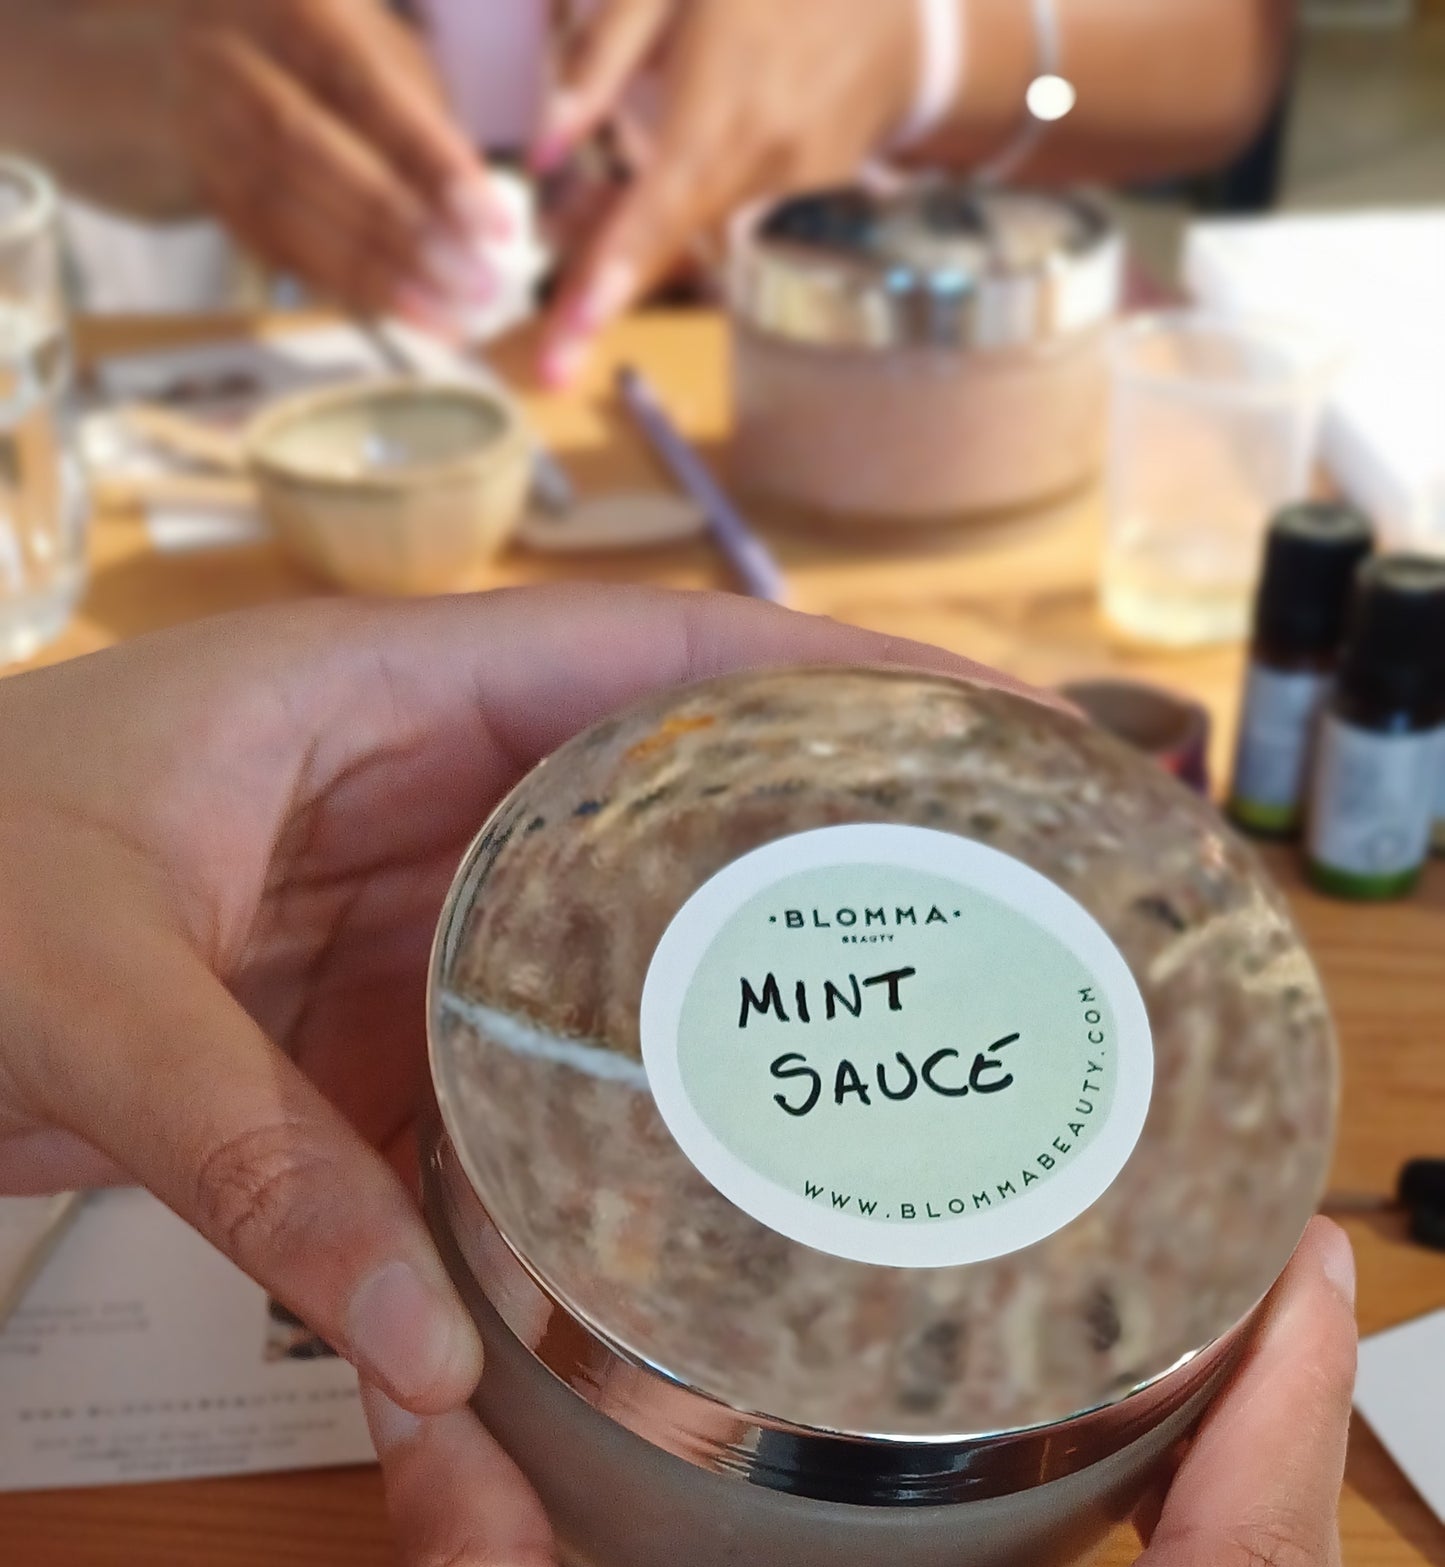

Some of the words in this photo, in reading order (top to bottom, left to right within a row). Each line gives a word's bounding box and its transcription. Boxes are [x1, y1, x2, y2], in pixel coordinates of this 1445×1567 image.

[841, 934, 896, 944] BEAUTY
[738, 966, 916, 1028] MINT
[803, 986, 1105, 1219] WWW.BLOMMABEAUTY.COM
